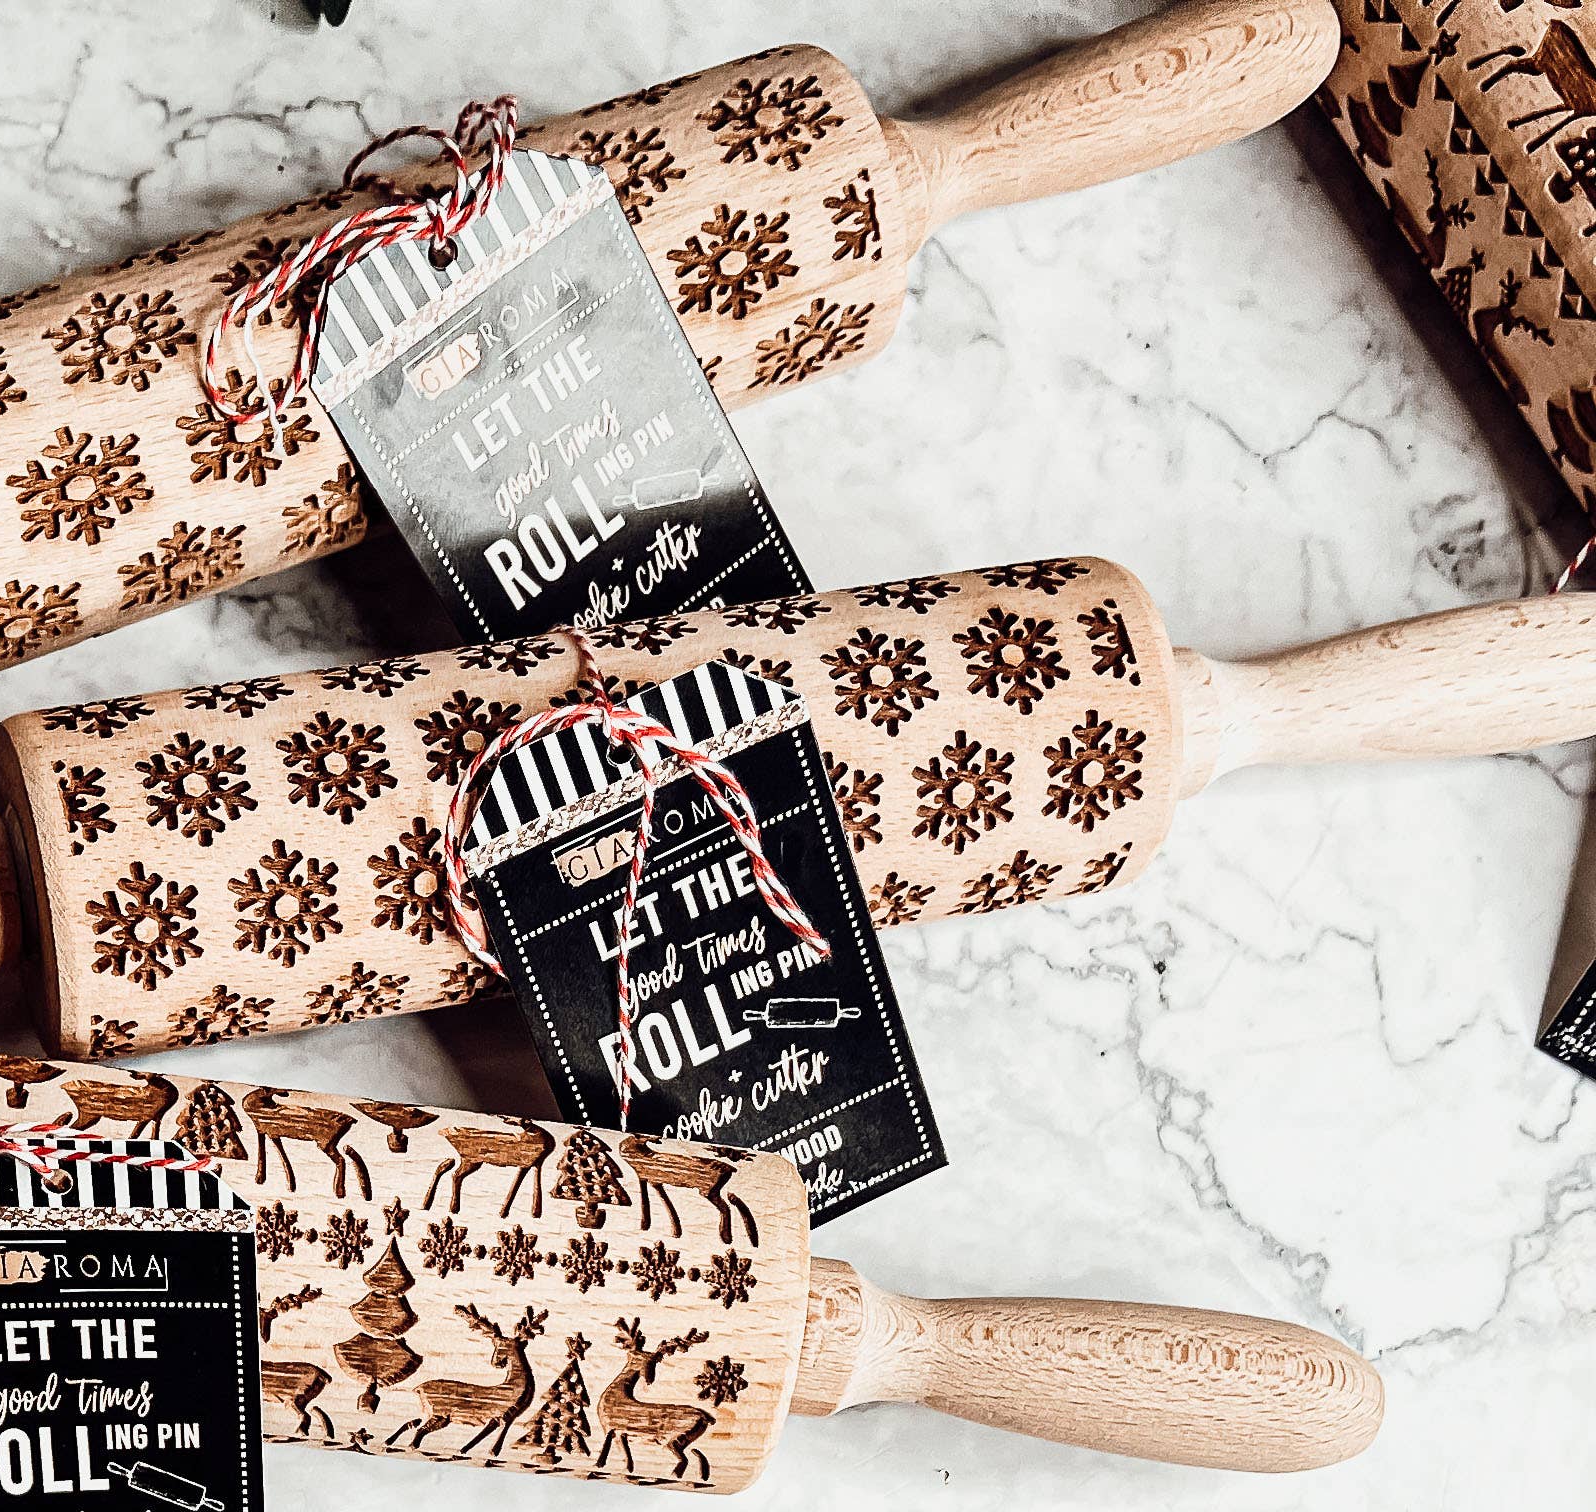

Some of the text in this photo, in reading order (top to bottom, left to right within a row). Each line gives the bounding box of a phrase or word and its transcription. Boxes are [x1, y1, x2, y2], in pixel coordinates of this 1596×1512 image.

[452, 334, 603, 473] LET THE
[484, 411, 675, 611] ROLL ING PIN
[495, 441, 550, 529] good
[636, 521, 701, 594] cutter
[589, 850, 756, 962] LET THE
[628, 943, 683, 1022] good
[598, 984, 752, 1093] ROLL
[730, 961, 773, 1000] ING
[752, 1044, 829, 1111] cutter
[72, 1318, 157, 1359] THE
[106, 1424, 147, 1450] ING
[158, 1423, 200, 1449] PIN
